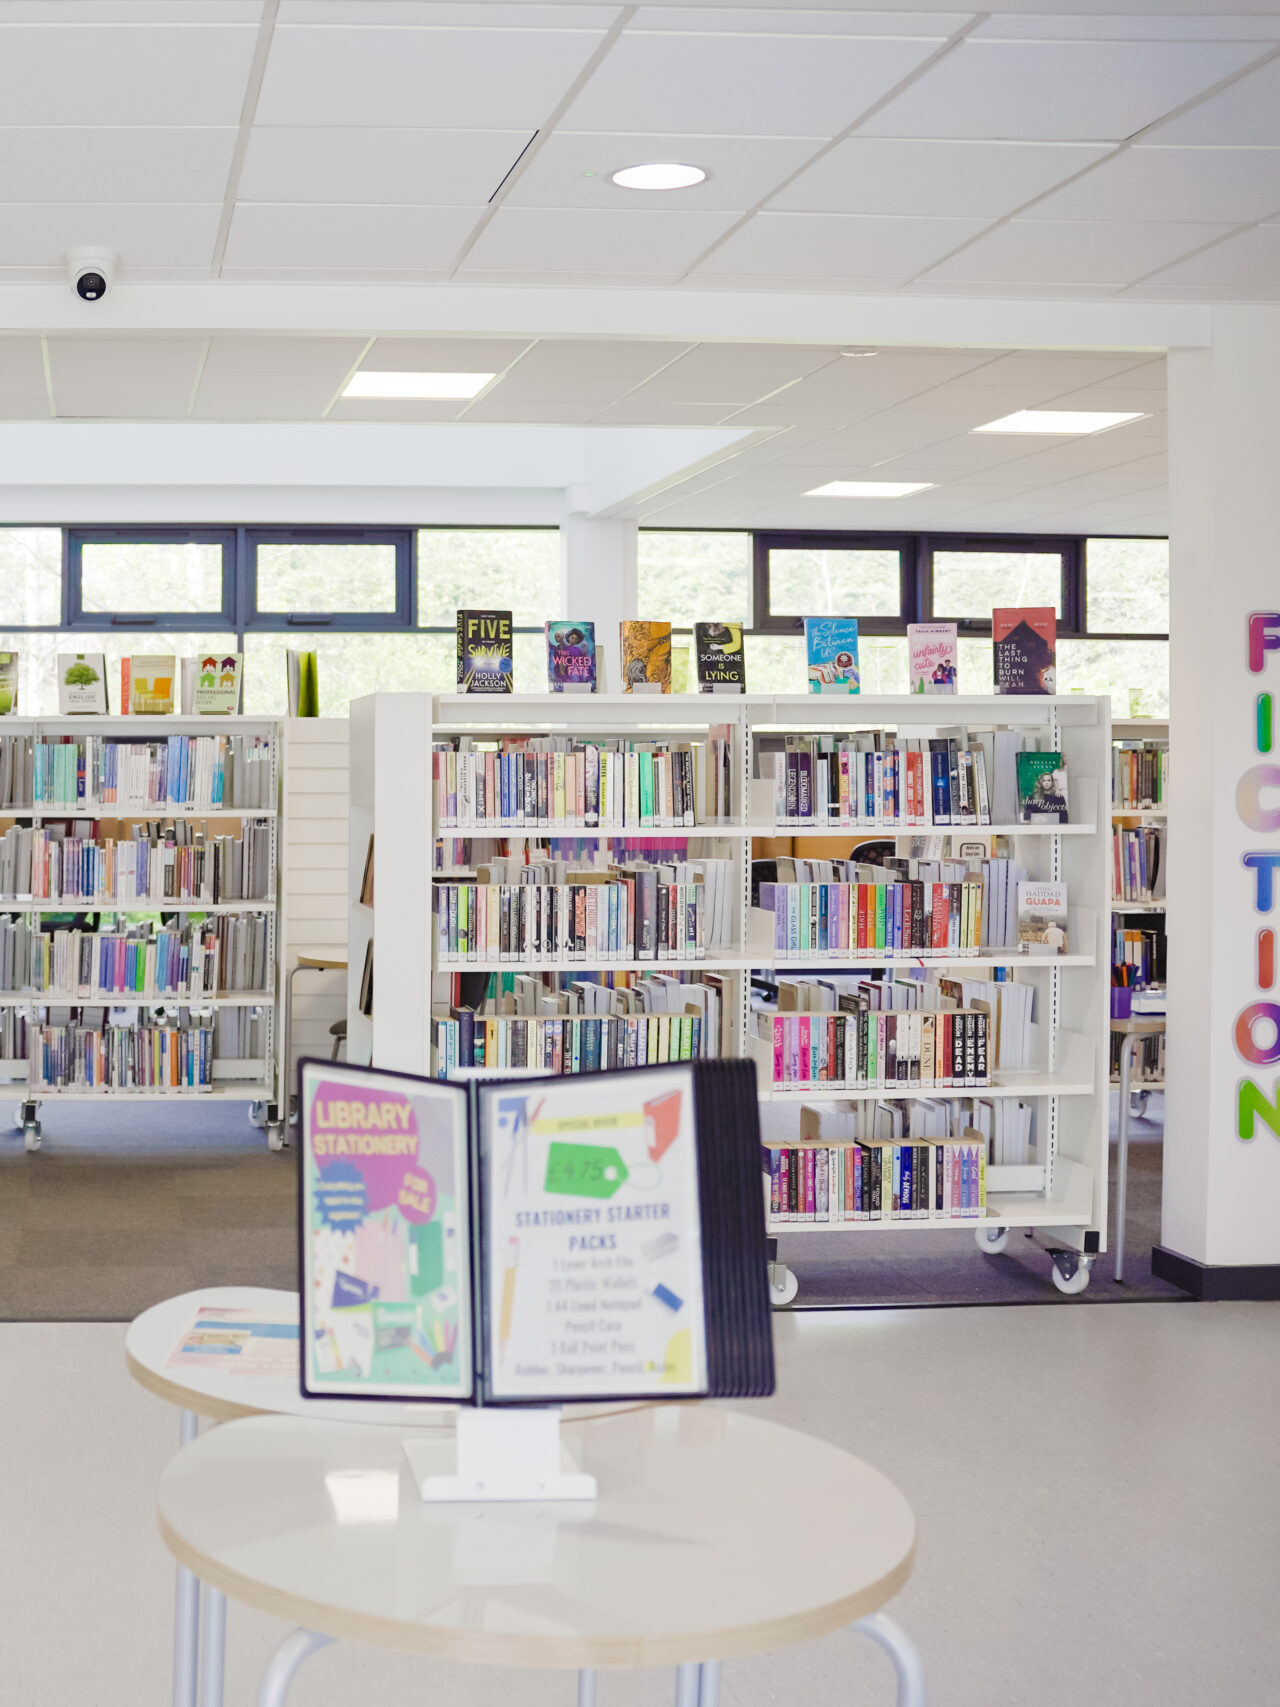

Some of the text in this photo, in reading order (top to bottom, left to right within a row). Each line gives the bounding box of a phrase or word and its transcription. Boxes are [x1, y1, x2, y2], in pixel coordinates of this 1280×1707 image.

[468, 619, 510, 639] FIVE
[468, 643, 510, 657] SURVIVE
[700, 654, 742, 662] SOMEONE
[912, 642, 953, 658] unfairly
[553, 656, 591, 667] WICKED
[914, 660, 935, 671] cute
[476, 672, 501, 680] HOLLY
[567, 666, 590, 677] FATE
[705, 671, 739, 681] LYING
[800, 771, 808, 812] BLOODMARKED
[478, 805, 485, 813] X
[1021, 796, 1045, 807] sharp
[1041, 801, 1067, 812] objects
[1233, 612, 1280, 1141] FICTION
[587, 888, 597, 930] PRETENDING
[1025, 897, 1062, 906] GUAPA
[923, 1042, 931, 1072] DUNE
[955, 1040, 963, 1072] DEAD
[967, 1039, 975, 1078] ENEMY
[978, 1039, 986, 1071] FEAR
[315, 1101, 412, 1130] LIBRARY
[312, 1134, 418, 1155] STATIONERY
[398, 1189, 432, 1214] SALE
[515, 1203, 671, 1227] STATIONERY STARTER
[568, 1234, 617, 1251] PACKS
